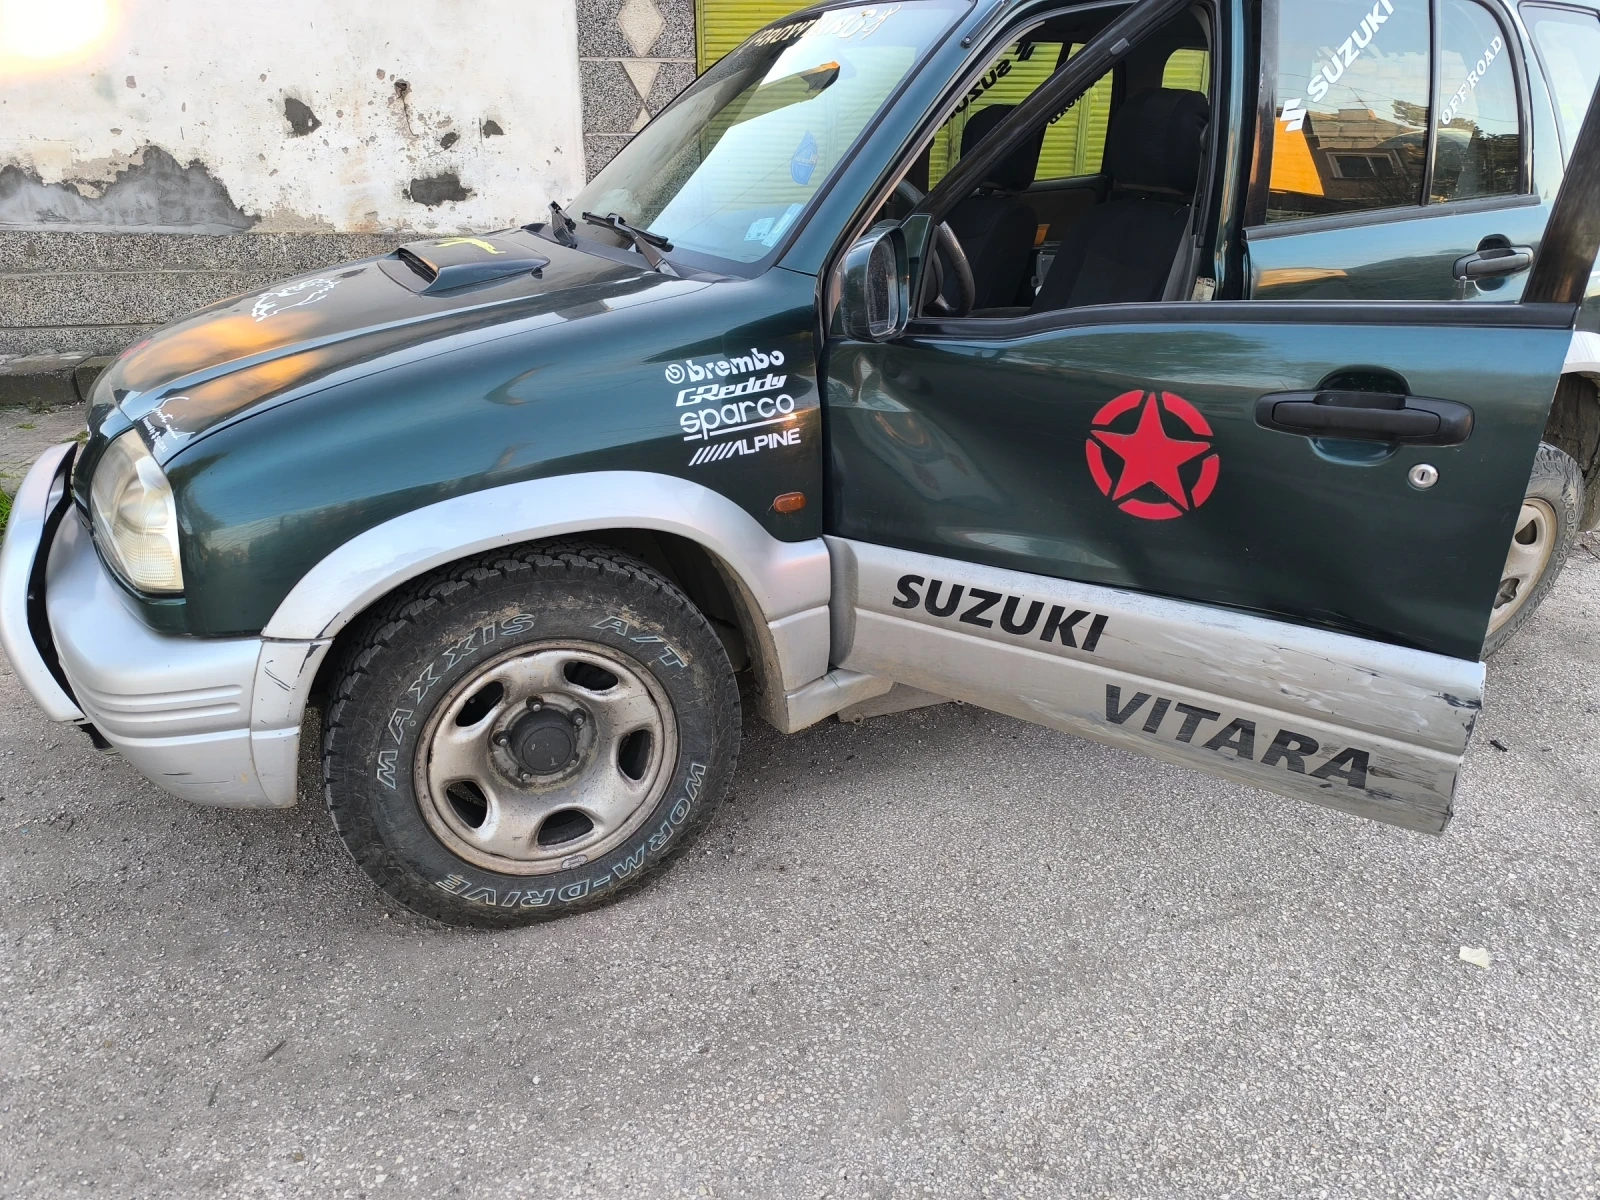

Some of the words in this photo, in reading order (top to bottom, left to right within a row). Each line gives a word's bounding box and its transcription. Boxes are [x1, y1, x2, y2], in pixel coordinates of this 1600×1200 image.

[1307, 0, 1394, 103] SUZUKI
[1442, 83, 1467, 125] OFF
[1467, 36, 1502, 91] ROAD
[685, 348, 785, 383] brembo
[679, 394, 795, 440] sparco
[726, 427, 802, 459] ALPINE
[592, 615, 688, 669] A/T
[892, 574, 1109, 652] SUZUKI
[376, 613, 535, 791] MAXXIS
[1105, 684, 1371, 790] VITARA
[435, 762, 707, 909] WORM-DRIVE
